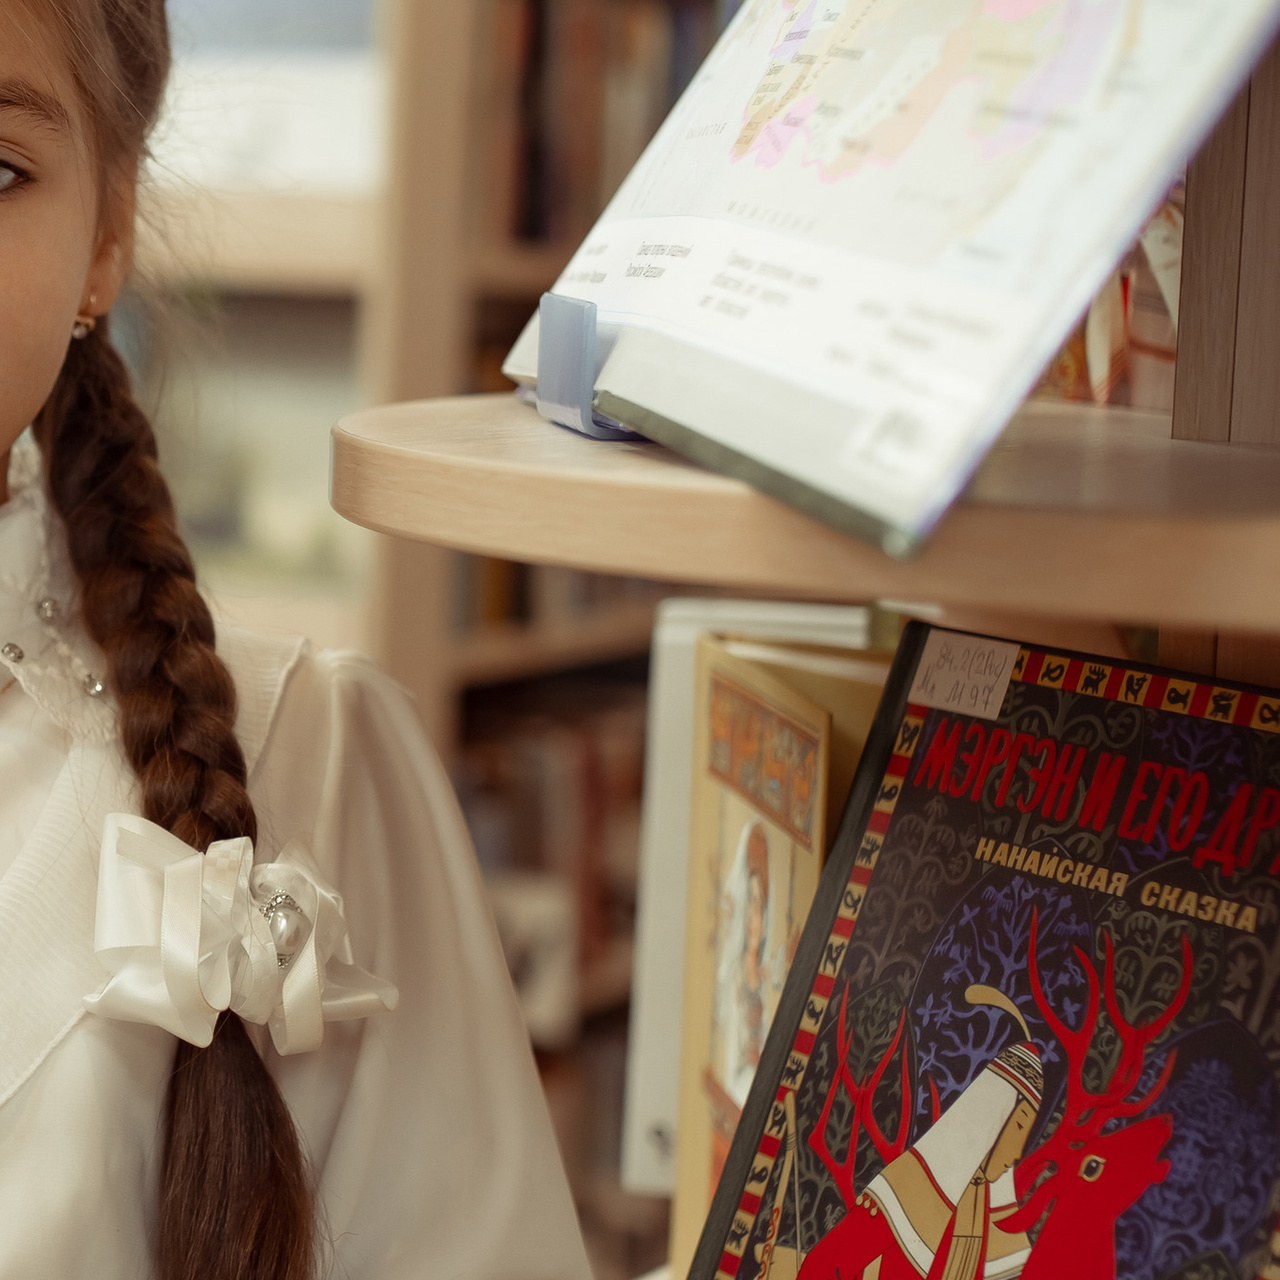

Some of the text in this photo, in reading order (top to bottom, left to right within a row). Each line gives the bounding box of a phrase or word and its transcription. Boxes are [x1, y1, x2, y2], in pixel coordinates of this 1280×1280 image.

[913, 717, 1280, 877] МЭРГЭН И ЕГО ДР
[974, 836, 1259, 934] НАНАЙСКАЯ СКАЗКА
